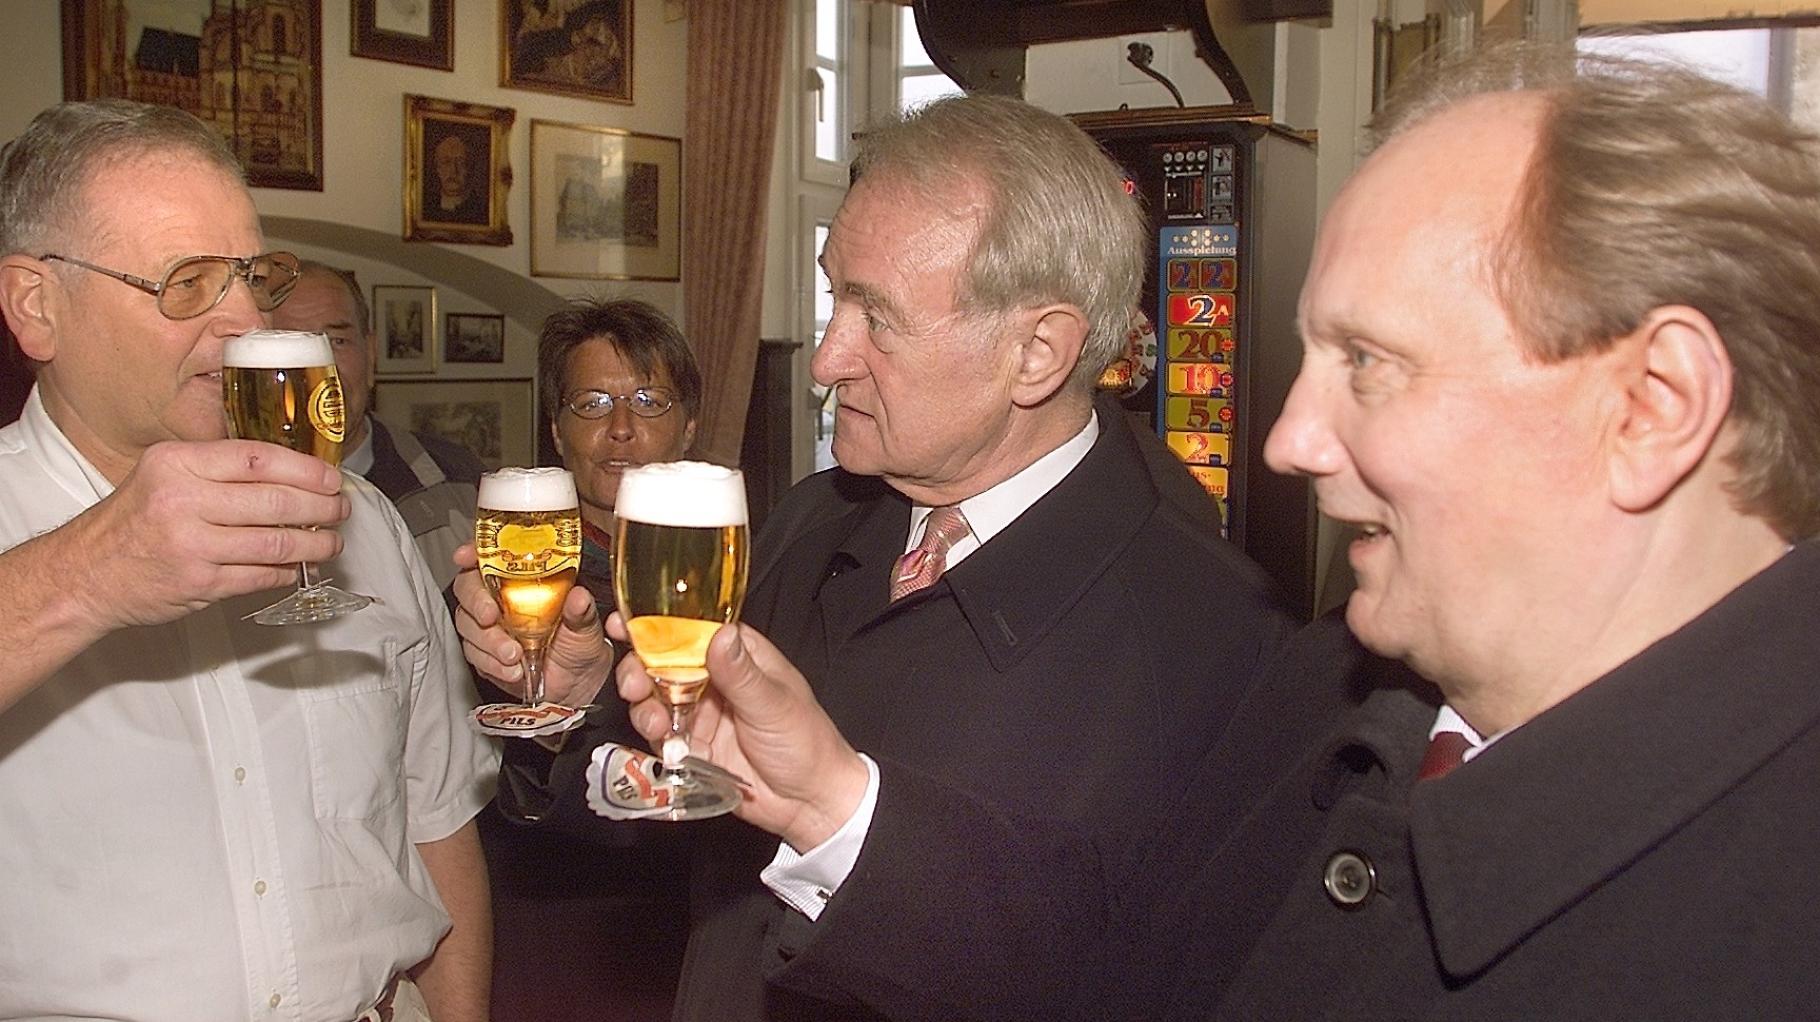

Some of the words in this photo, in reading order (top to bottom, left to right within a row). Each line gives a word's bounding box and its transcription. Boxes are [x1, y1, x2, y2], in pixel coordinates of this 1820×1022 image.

[1178, 329, 1222, 358] 20
[1179, 365, 1220, 393] 10
[1187, 398, 1210, 427] 5
[1185, 433, 1209, 462] 2
[500, 717, 536, 726] PILS
